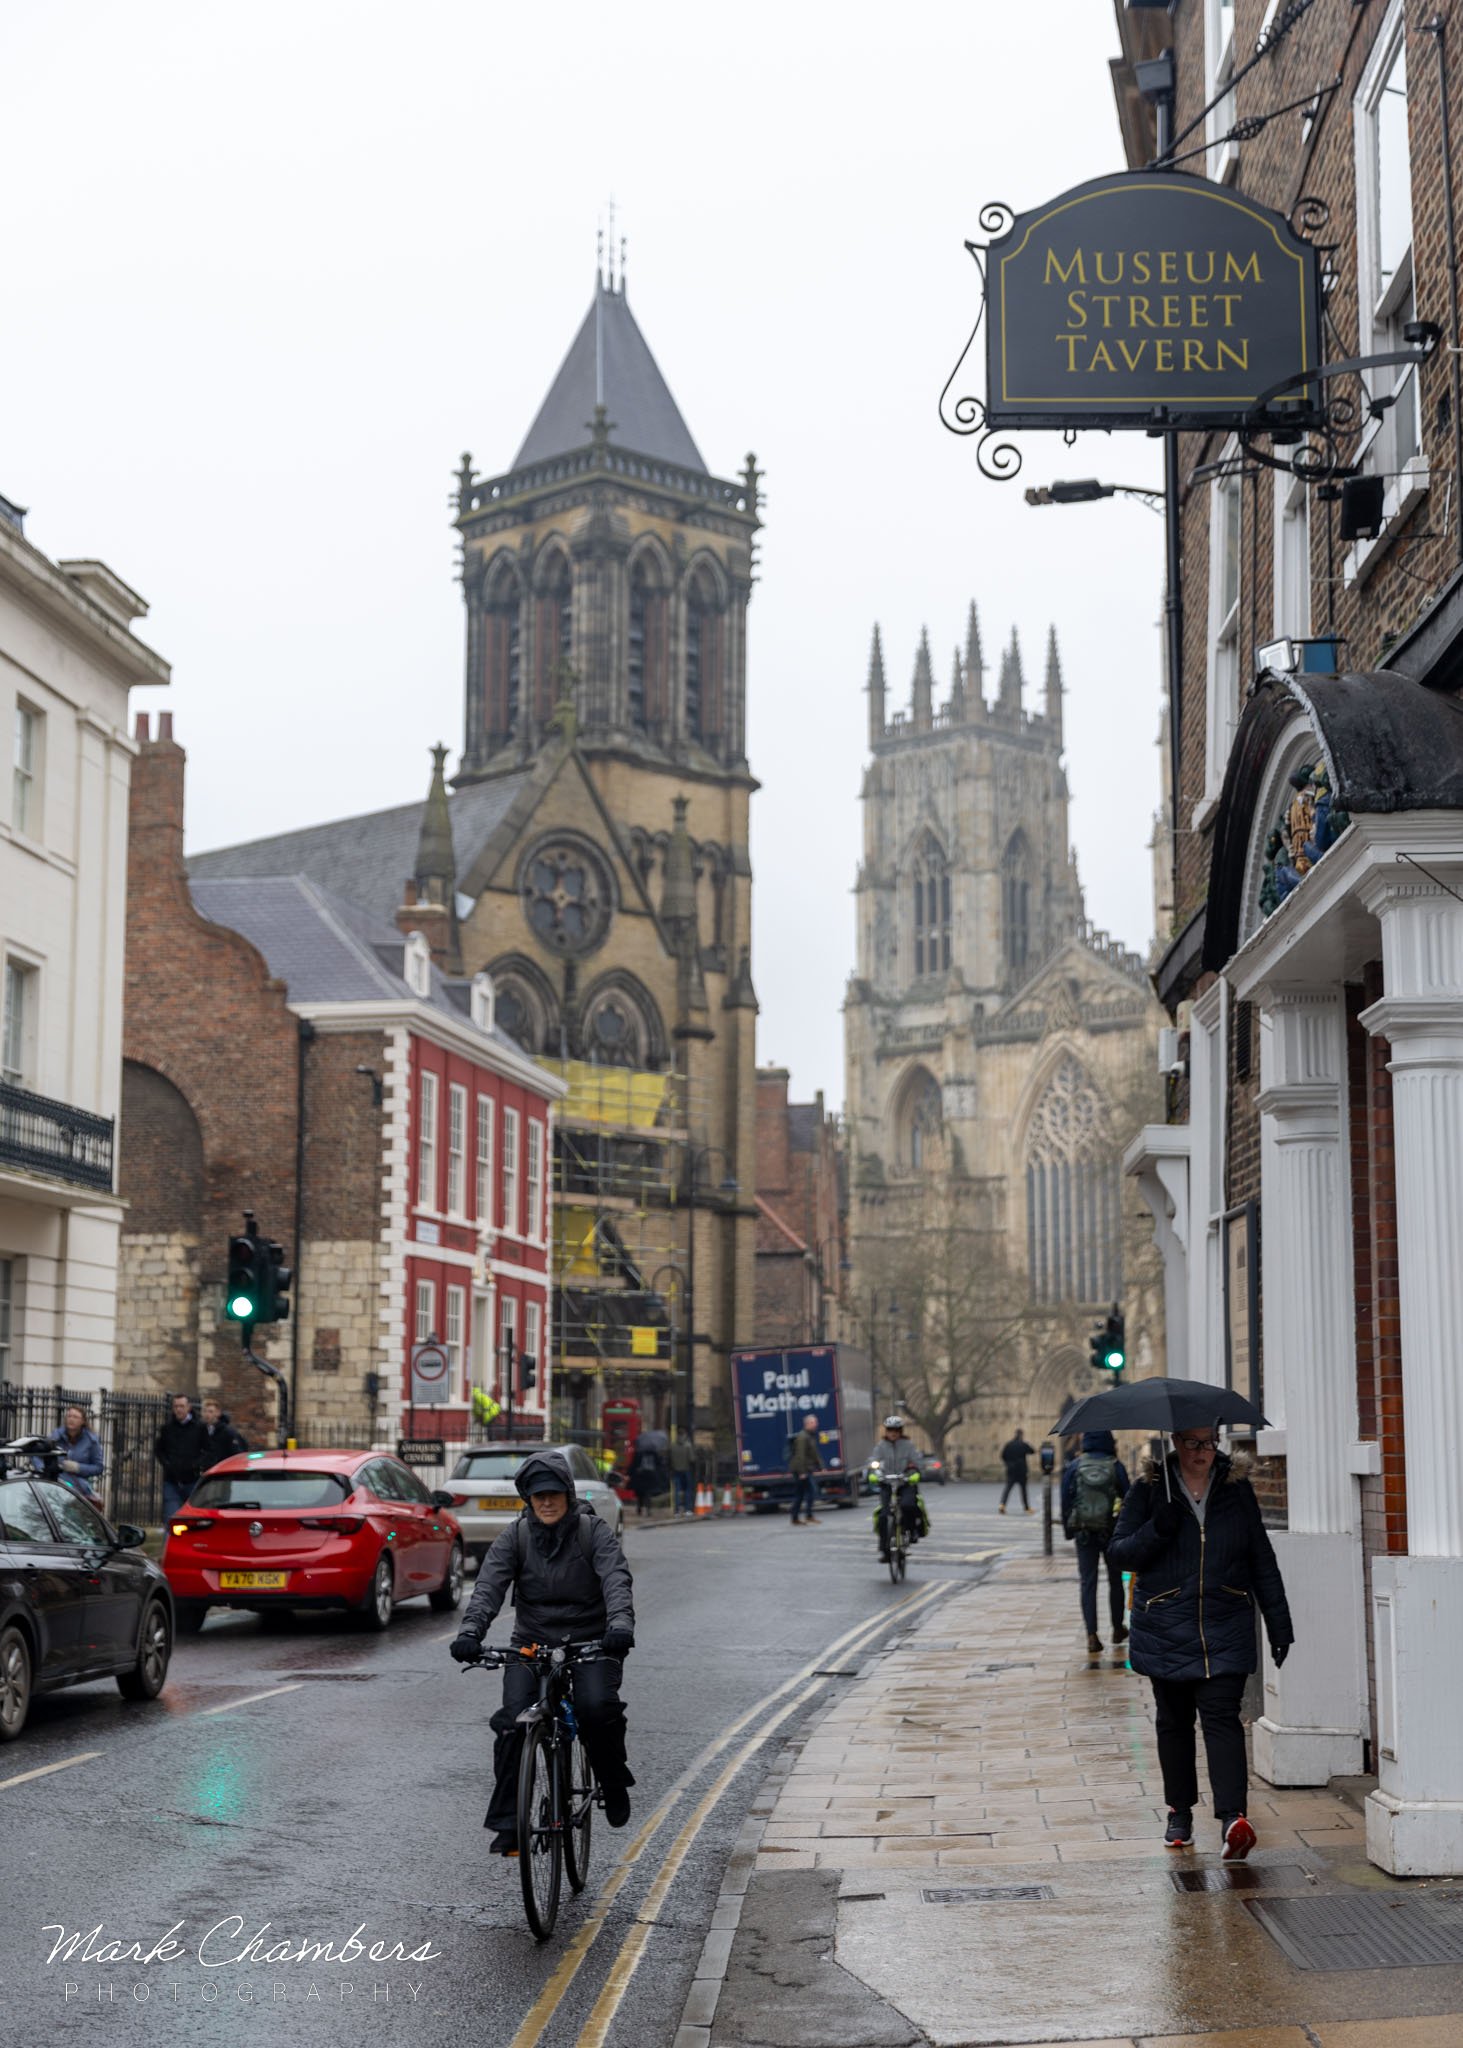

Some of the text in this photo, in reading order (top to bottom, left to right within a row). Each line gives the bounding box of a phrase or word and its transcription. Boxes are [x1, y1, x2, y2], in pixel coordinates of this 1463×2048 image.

[1043, 247, 1264, 284] MUSEUM
[1066, 290, 1242, 328] STREET
[1055, 334, 1249, 372] TAVERN
[762, 1368, 810, 1391] Paul
[745, 1392, 829, 1413] Mathew
